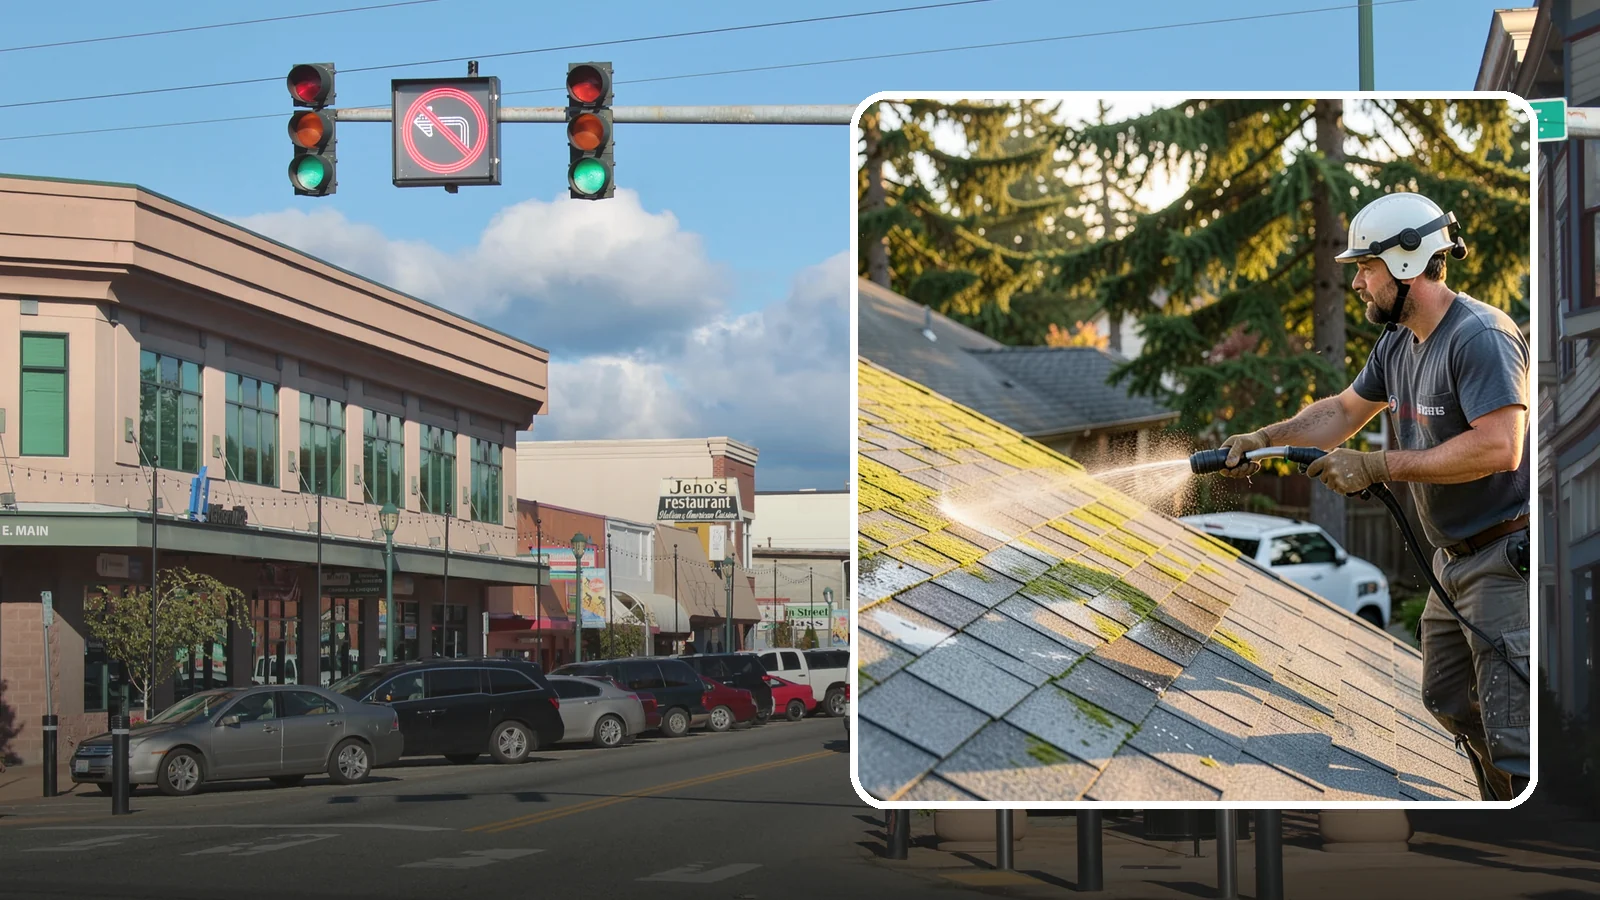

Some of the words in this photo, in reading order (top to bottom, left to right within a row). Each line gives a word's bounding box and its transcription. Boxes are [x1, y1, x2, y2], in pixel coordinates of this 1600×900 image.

[669, 480, 728, 495] Jeno's
[665, 496, 731, 509] restaurant
[658, 509, 681, 519] Italian
[686, 509, 714, 519] American
[715, 509, 737, 519] Cuisine
[2, 525, 13, 536] E.
[15, 525, 49, 536] MAIN
[797, 607, 828, 617] Street
